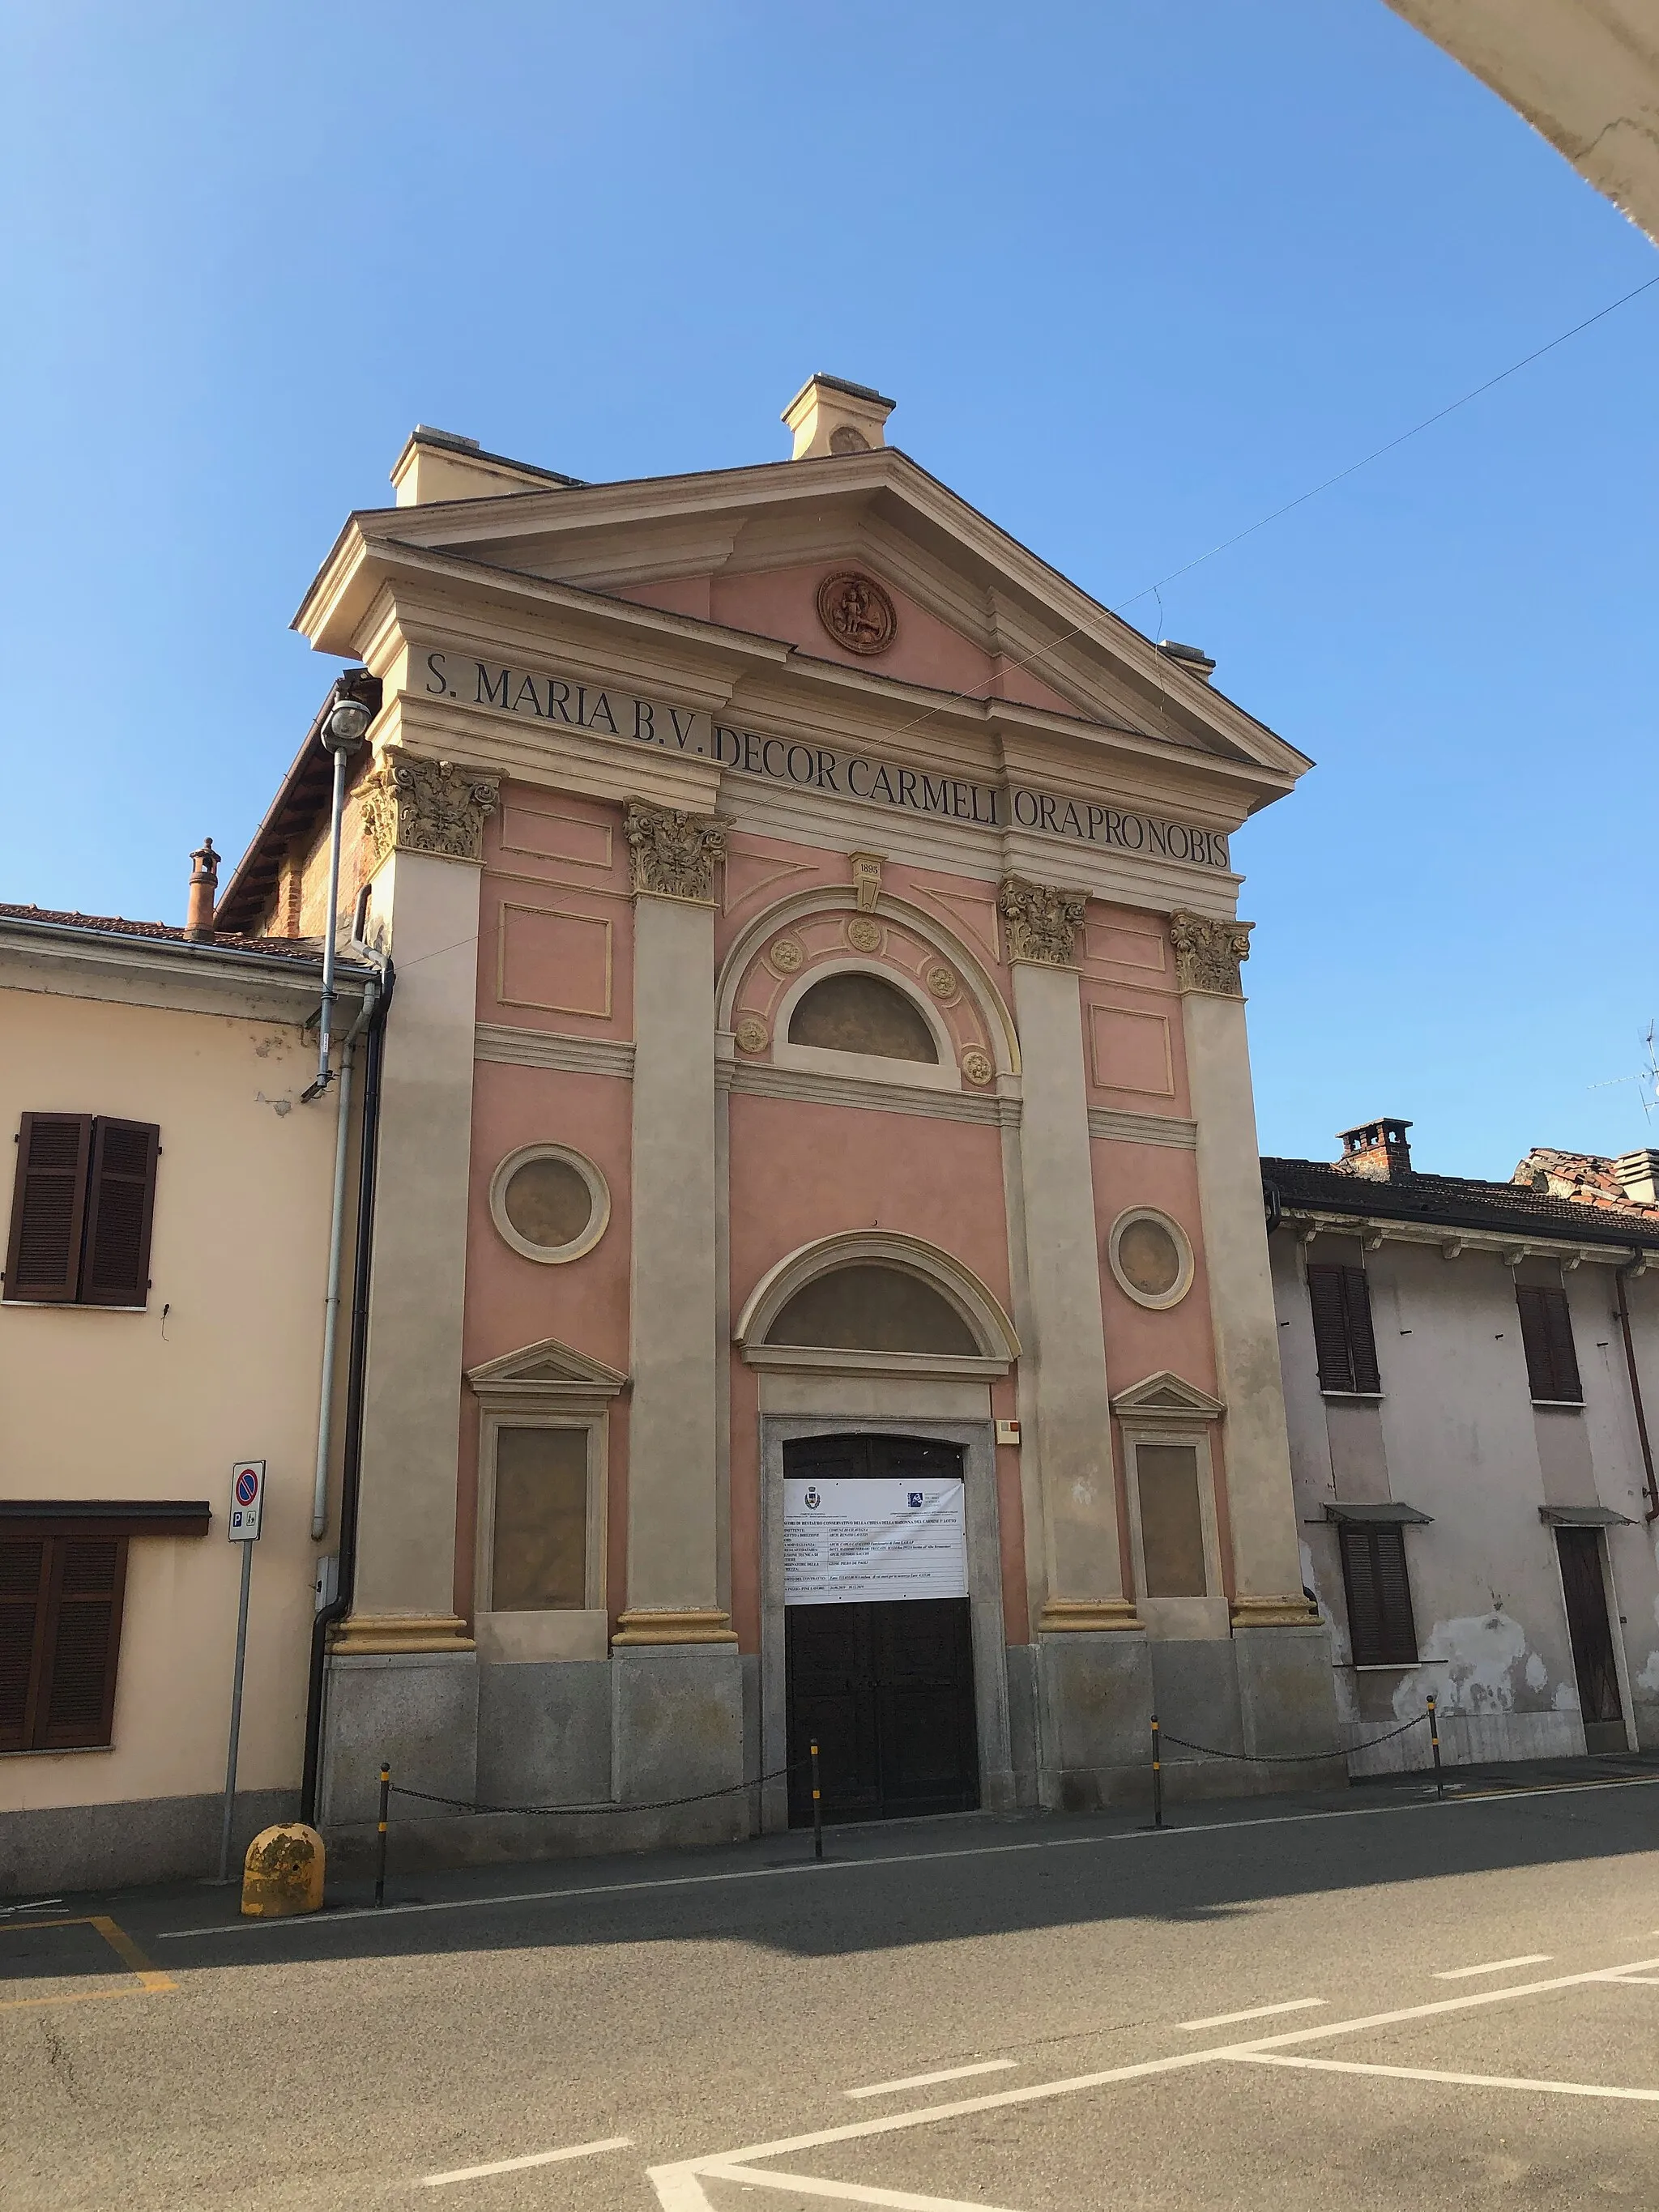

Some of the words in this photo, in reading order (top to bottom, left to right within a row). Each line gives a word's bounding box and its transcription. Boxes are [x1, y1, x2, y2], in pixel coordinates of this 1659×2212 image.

[425, 653, 457, 698] S.
[473, 663, 619, 734] MARIA
[633, 700, 703, 752] B.V.
[714, 727, 840, 791] DECOR
[847, 759, 999, 825] CARMELI
[234, 1513, 241, 1526] P
